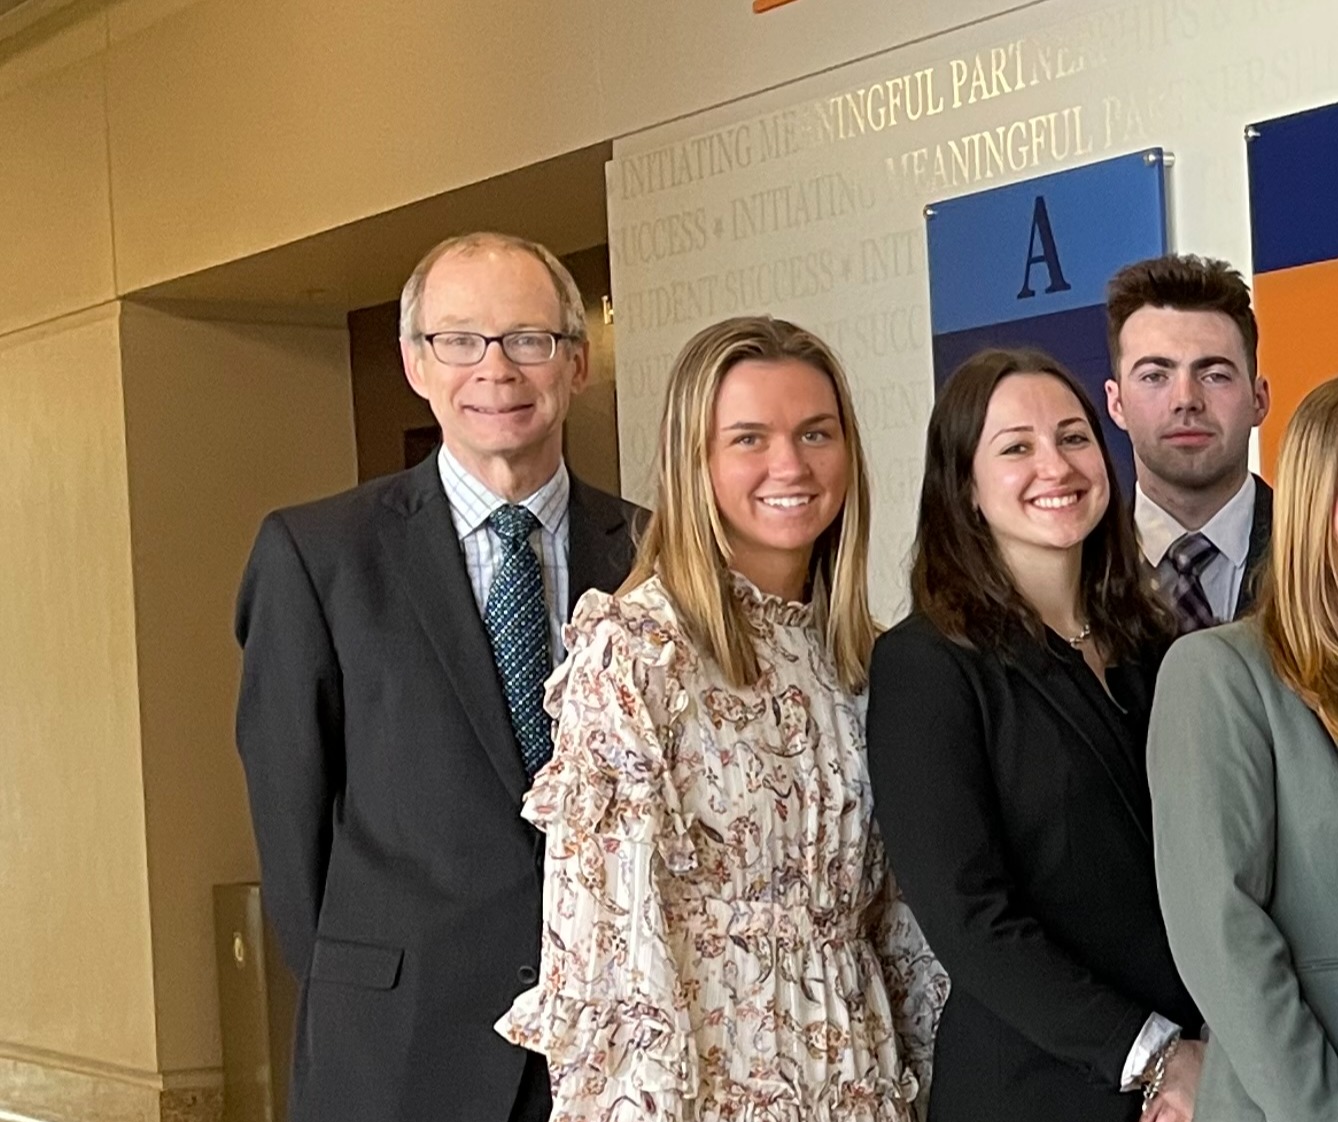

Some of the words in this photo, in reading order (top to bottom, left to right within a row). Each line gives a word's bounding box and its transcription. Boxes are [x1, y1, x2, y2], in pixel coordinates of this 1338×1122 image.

[620, 125, 753, 199] INITIATING
[724, 247, 835, 311] SUCCESS
[1017, 196, 1071, 299] A
